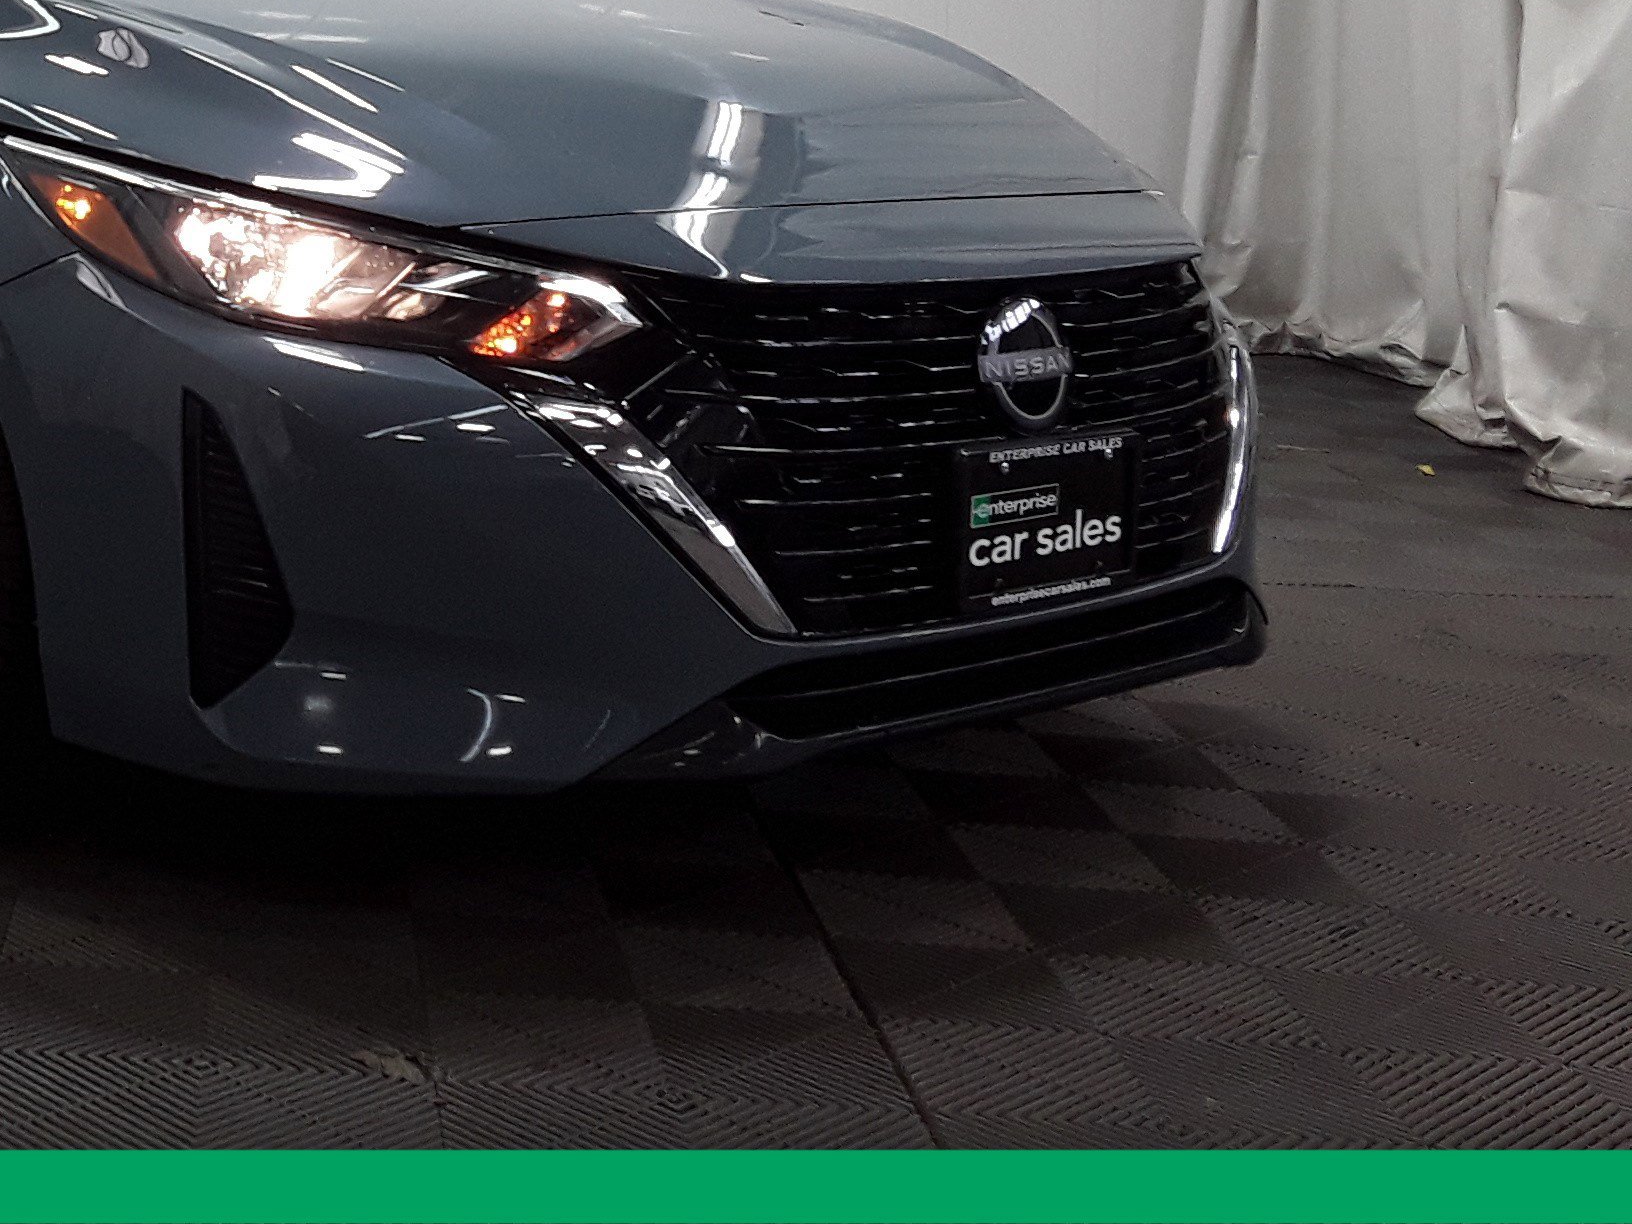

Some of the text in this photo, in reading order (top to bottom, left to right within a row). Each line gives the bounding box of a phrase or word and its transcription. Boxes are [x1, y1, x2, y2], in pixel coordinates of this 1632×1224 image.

[983, 350, 1071, 379] NISSAN
[988, 436, 1123, 463] ENTERPRISE CAR SALES
[973, 492, 1058, 518] enterprise
[969, 508, 1123, 567] car sales
[991, 576, 1112, 607] enterprisecarsales.com
